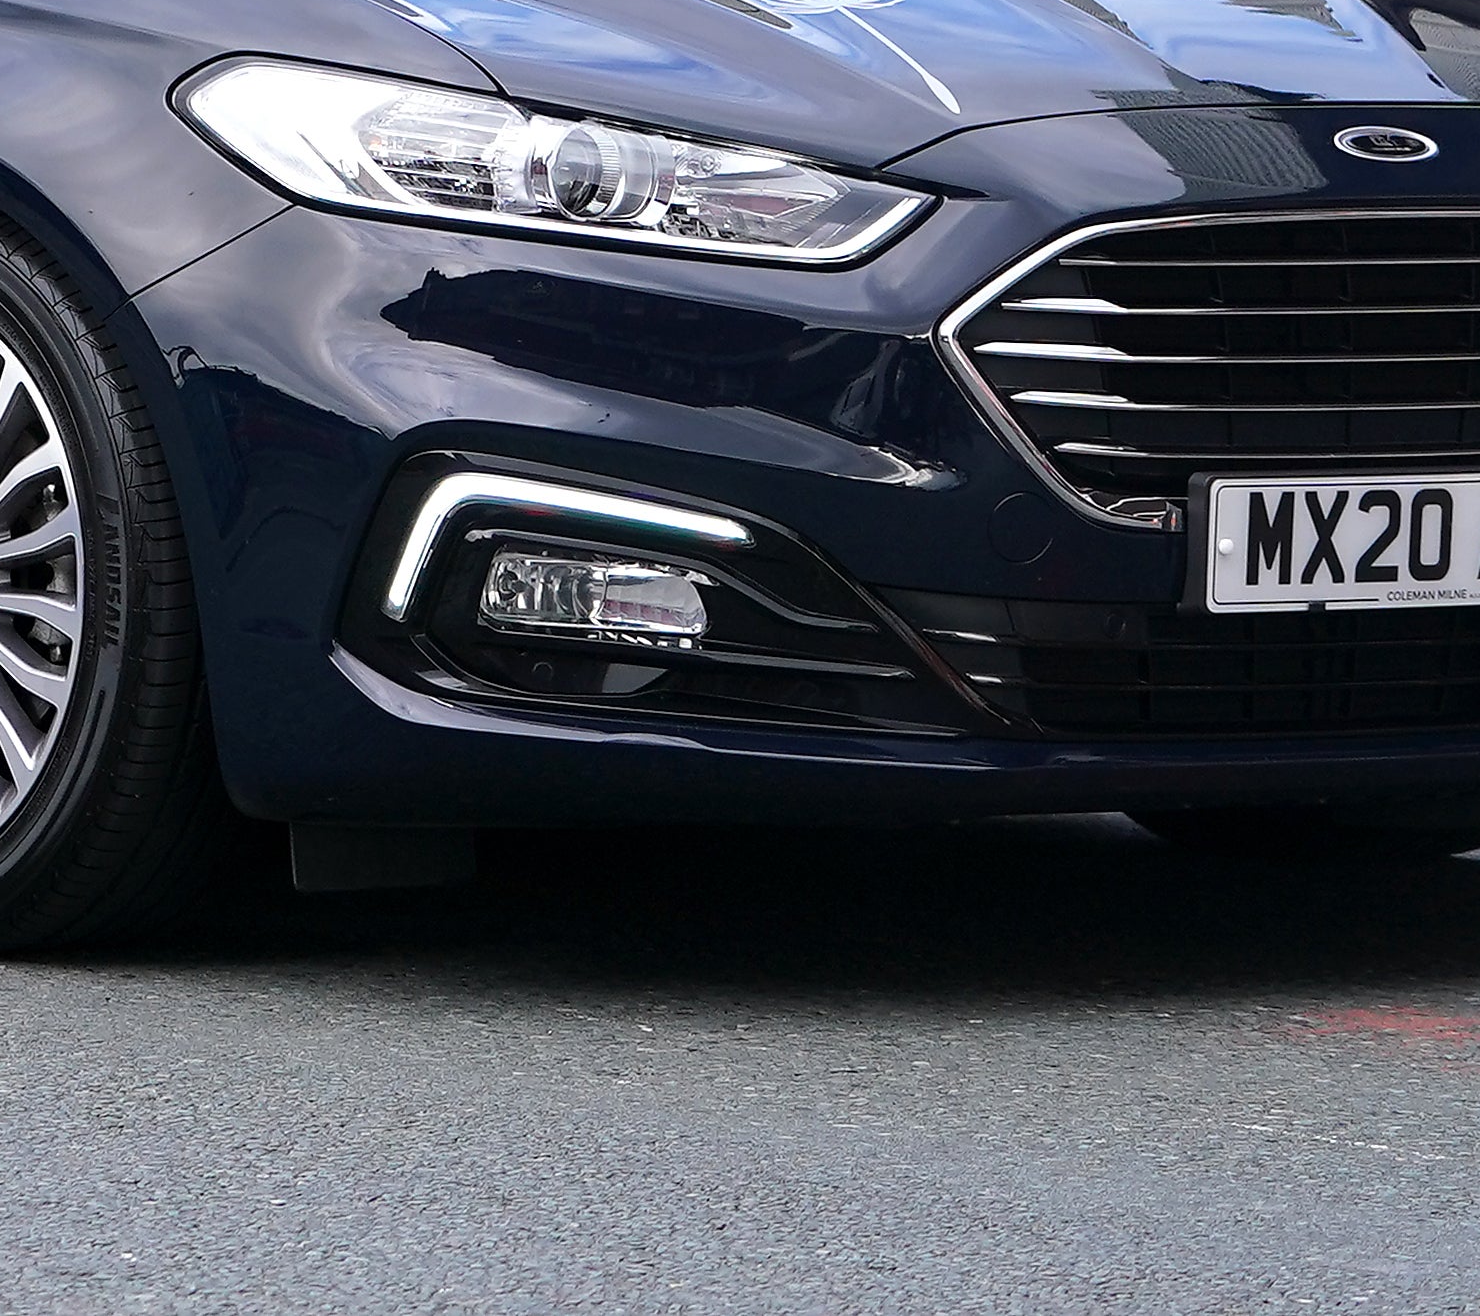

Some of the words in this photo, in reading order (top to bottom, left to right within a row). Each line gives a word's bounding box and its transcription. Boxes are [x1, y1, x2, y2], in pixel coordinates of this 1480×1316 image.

[1246, 489, 1452, 586] MX20
[1386, 590, 1436, 601] COLEMAN
[1438, 589, 1468, 600] MILNE
